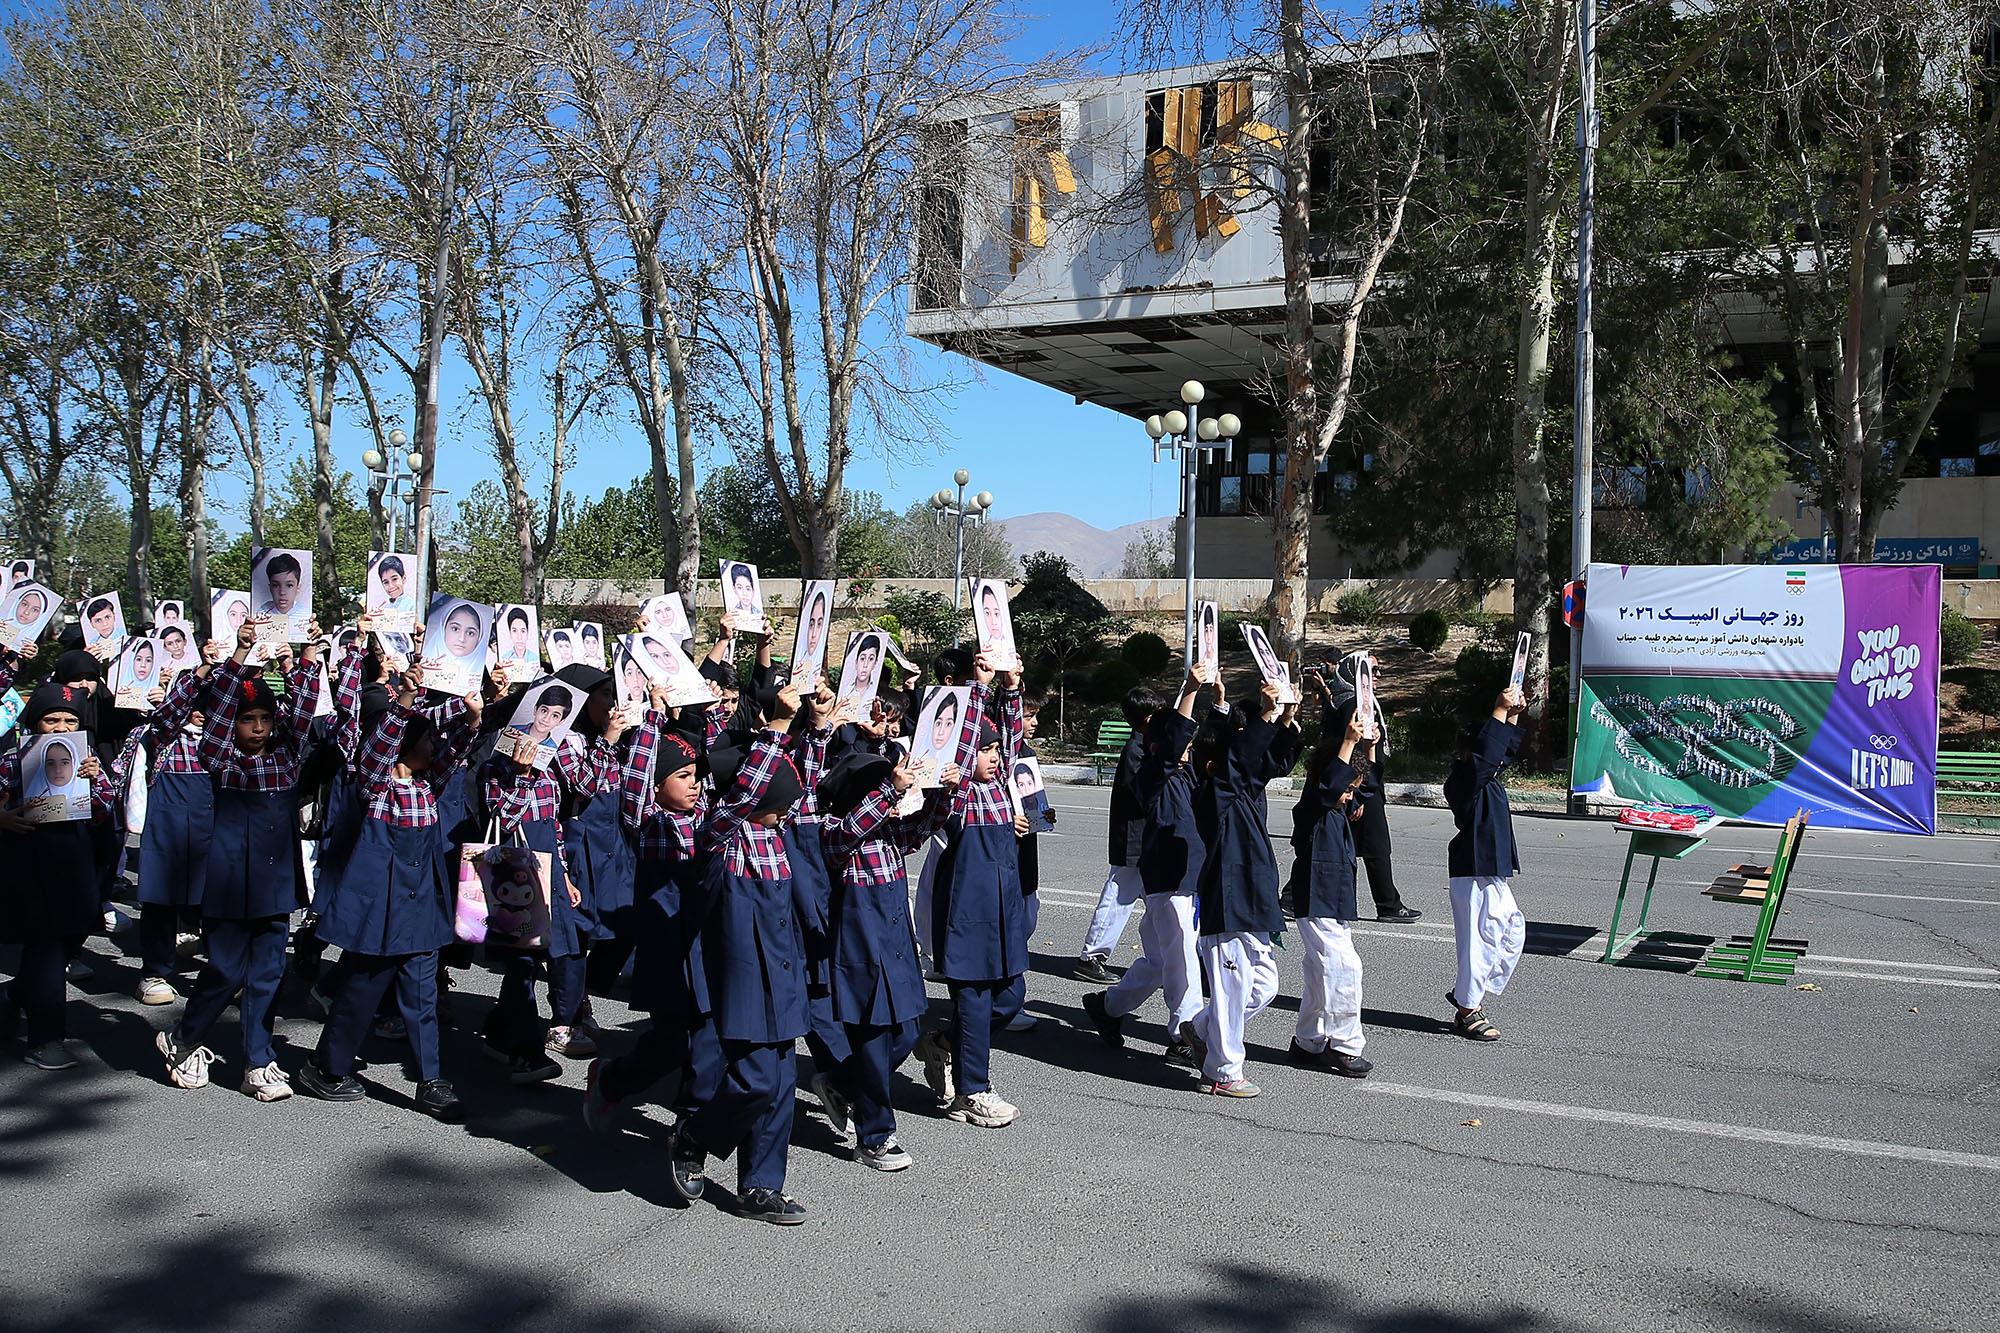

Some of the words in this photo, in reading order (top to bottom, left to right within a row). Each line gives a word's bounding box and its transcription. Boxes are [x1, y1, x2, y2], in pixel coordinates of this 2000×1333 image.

[1916, 544, 1953, 561] اماکن
[1658, 606, 1719, 627] المپیک
[1722, 607, 1779, 626] جهانی
[1782, 609, 1804, 626] روز
[1616, 632, 1637, 644] میناب
[1644, 633, 1661, 644] طیبه
[1662, 633, 1683, 644] شجره
[1685, 634, 1709, 645] مدرسه
[1710, 633, 1726, 645] آموز
[1728, 634, 1749, 645] دانش
[1751, 635, 1777, 646] شهدای
[1779, 635, 1804, 647] یادواره
[1858, 625, 1900, 660] YOU
[1667, 646, 1685, 655] خرداد
[1699, 646, 1716, 656] آزادی
[1718, 647, 1739, 657] ورزشی
[1740, 648, 1766, 657] مجموعه
[1851, 651, 1889, 685] CAN
[1891, 644, 1921, 674] DO
[1866, 672, 1914, 708] THIS
[1851, 748, 1888, 790] LET'S
[1890, 757, 1914, 787] MOVE
